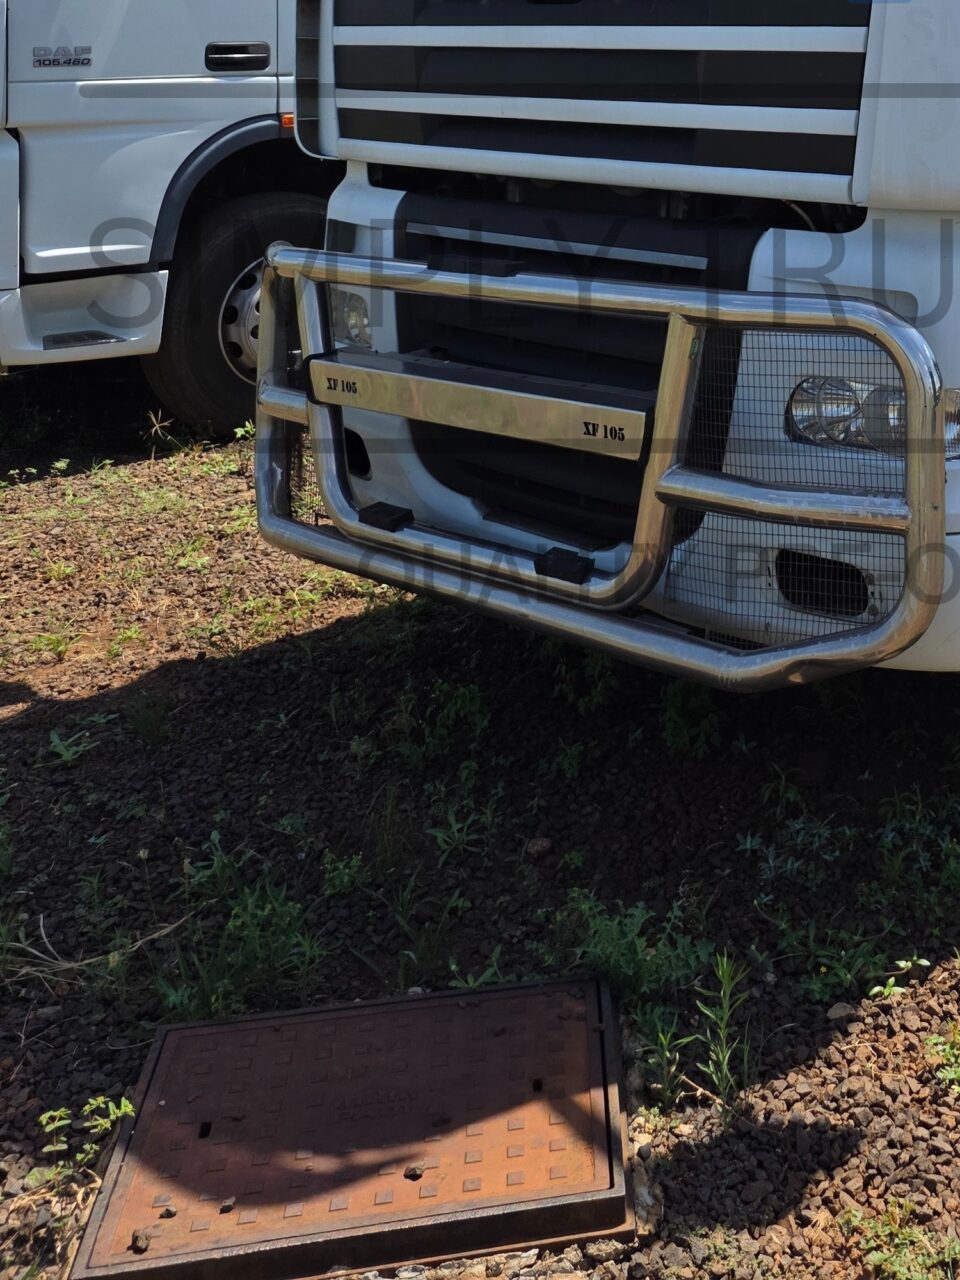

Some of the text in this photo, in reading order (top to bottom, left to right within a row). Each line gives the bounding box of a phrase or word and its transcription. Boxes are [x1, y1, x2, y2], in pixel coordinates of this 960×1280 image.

[33, 46, 92, 57] DAF
[34, 58, 91, 67] 105.460
[326, 377, 358, 394] XF 105
[583, 421, 626, 442] XF 105
